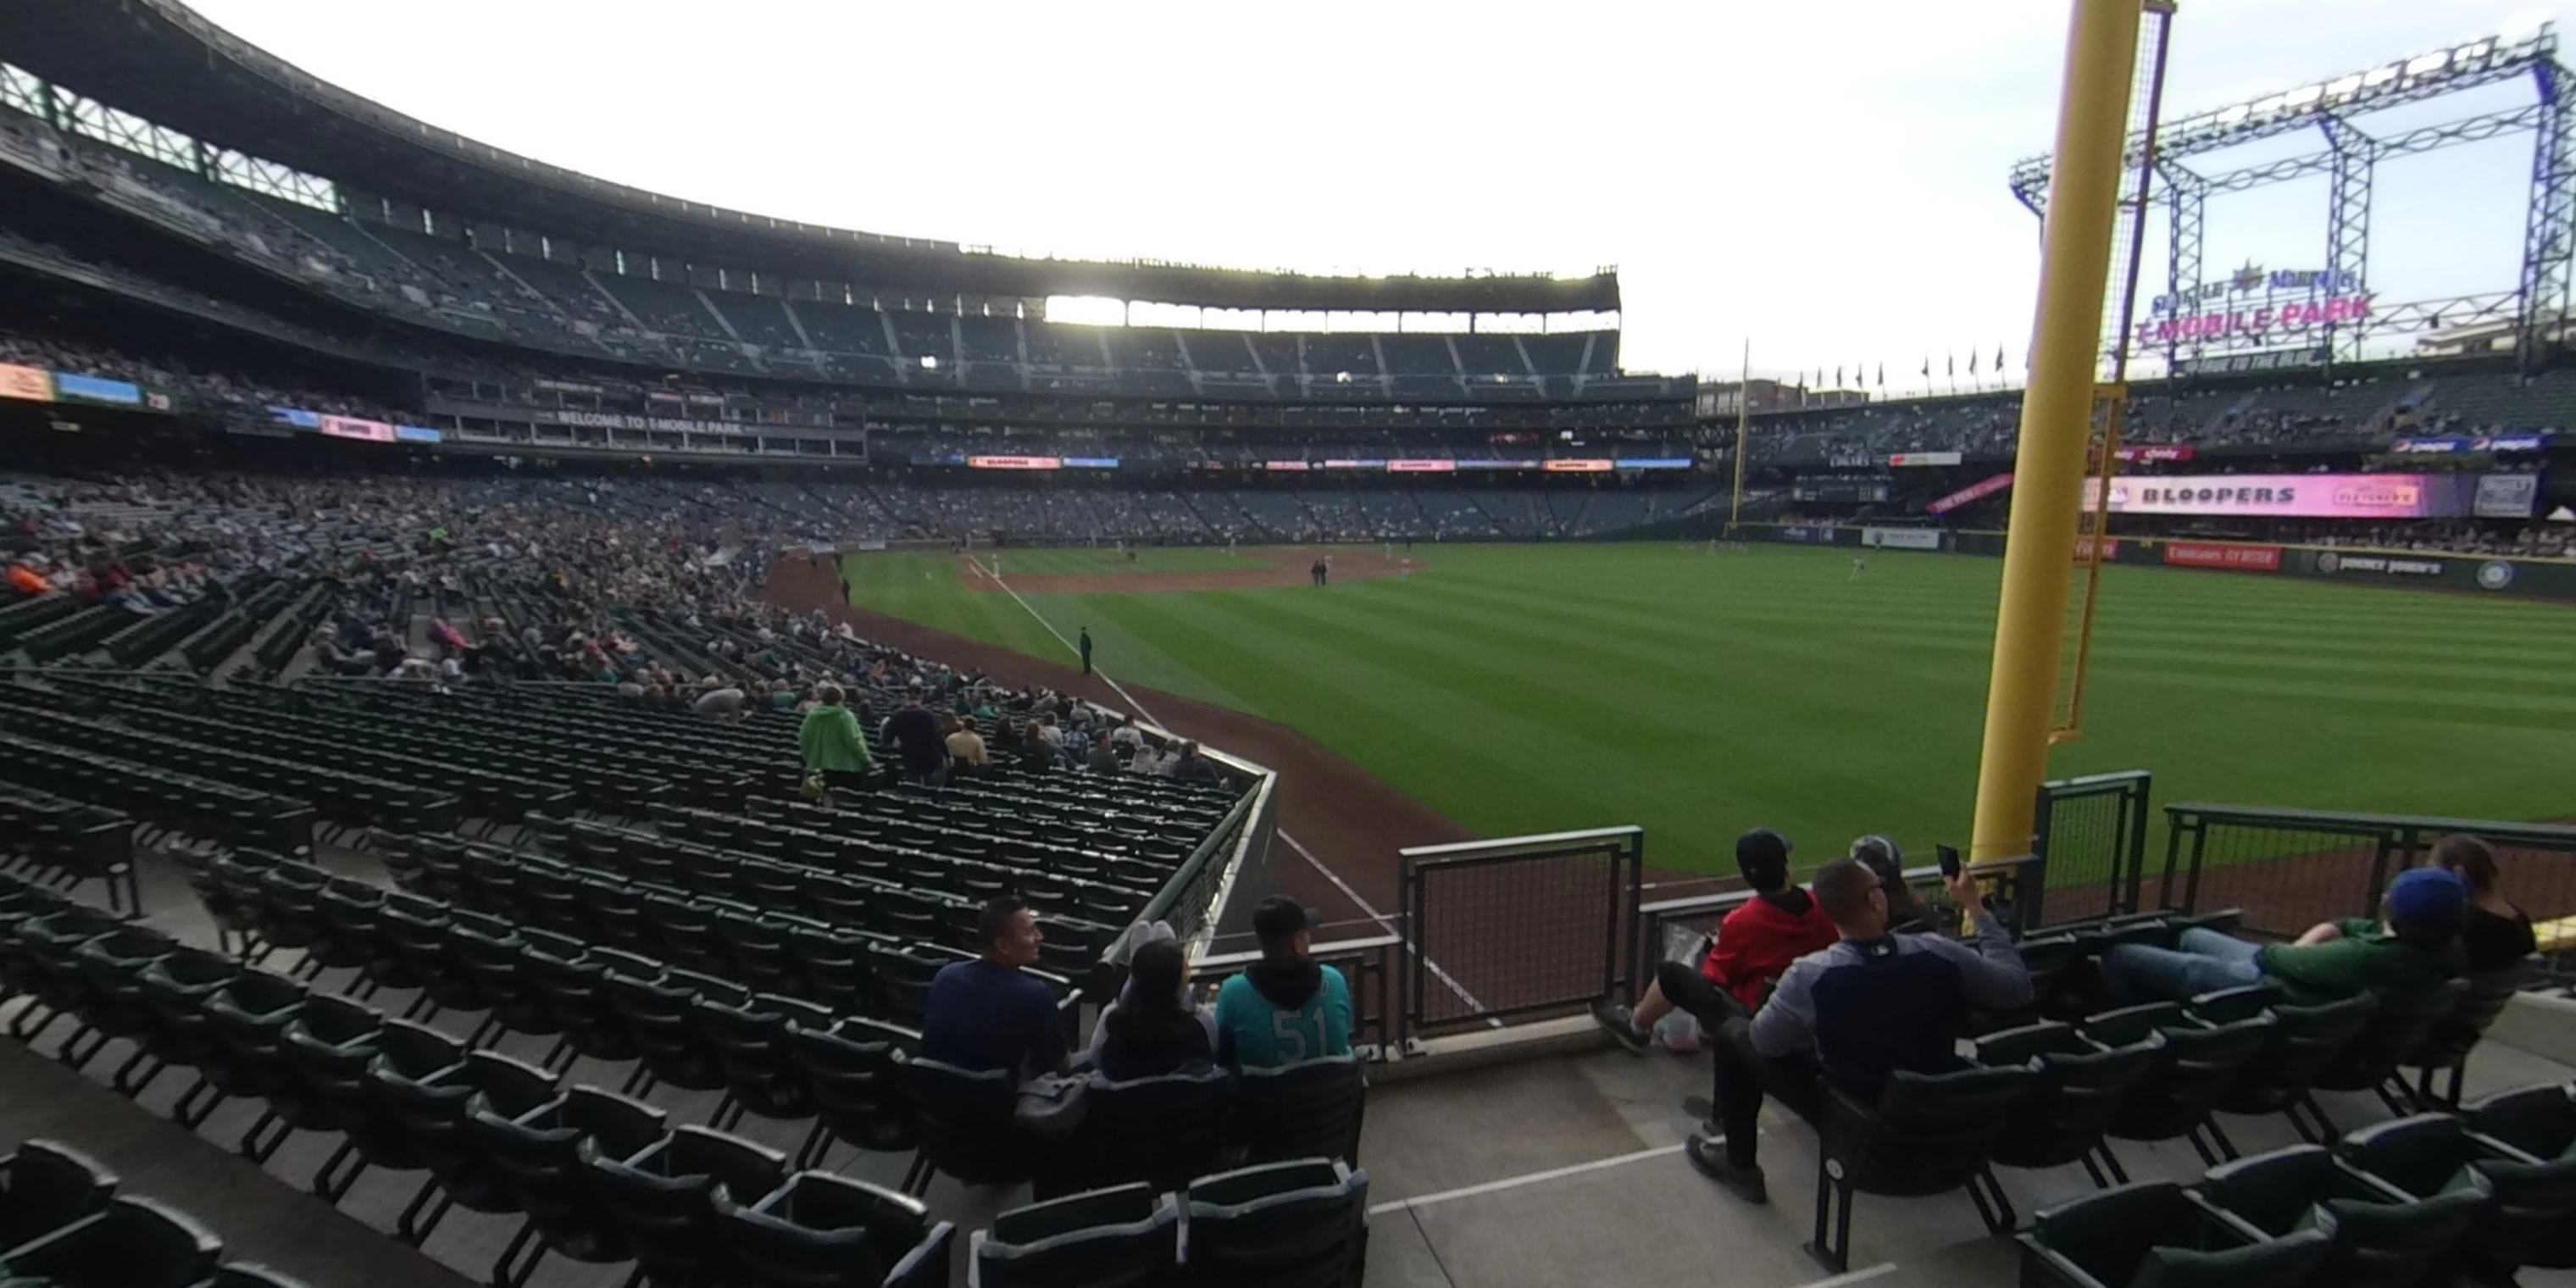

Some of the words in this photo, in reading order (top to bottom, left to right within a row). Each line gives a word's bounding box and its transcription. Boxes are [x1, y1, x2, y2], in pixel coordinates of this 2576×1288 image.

[2135, 306, 2274, 342] T-MOBILE
[2279, 291, 2374, 325] PARK
[2251, 353, 2278, 369] THE
[558, 410, 621, 427] WELCOME
[625, 415, 644, 429] TO
[648, 417, 705, 432] T-MOBILE
[707, 420, 742, 434] PARK
[2141, 487, 2296, 505] BLOOPERS
[1273, 1005, 1329, 1059] 51
